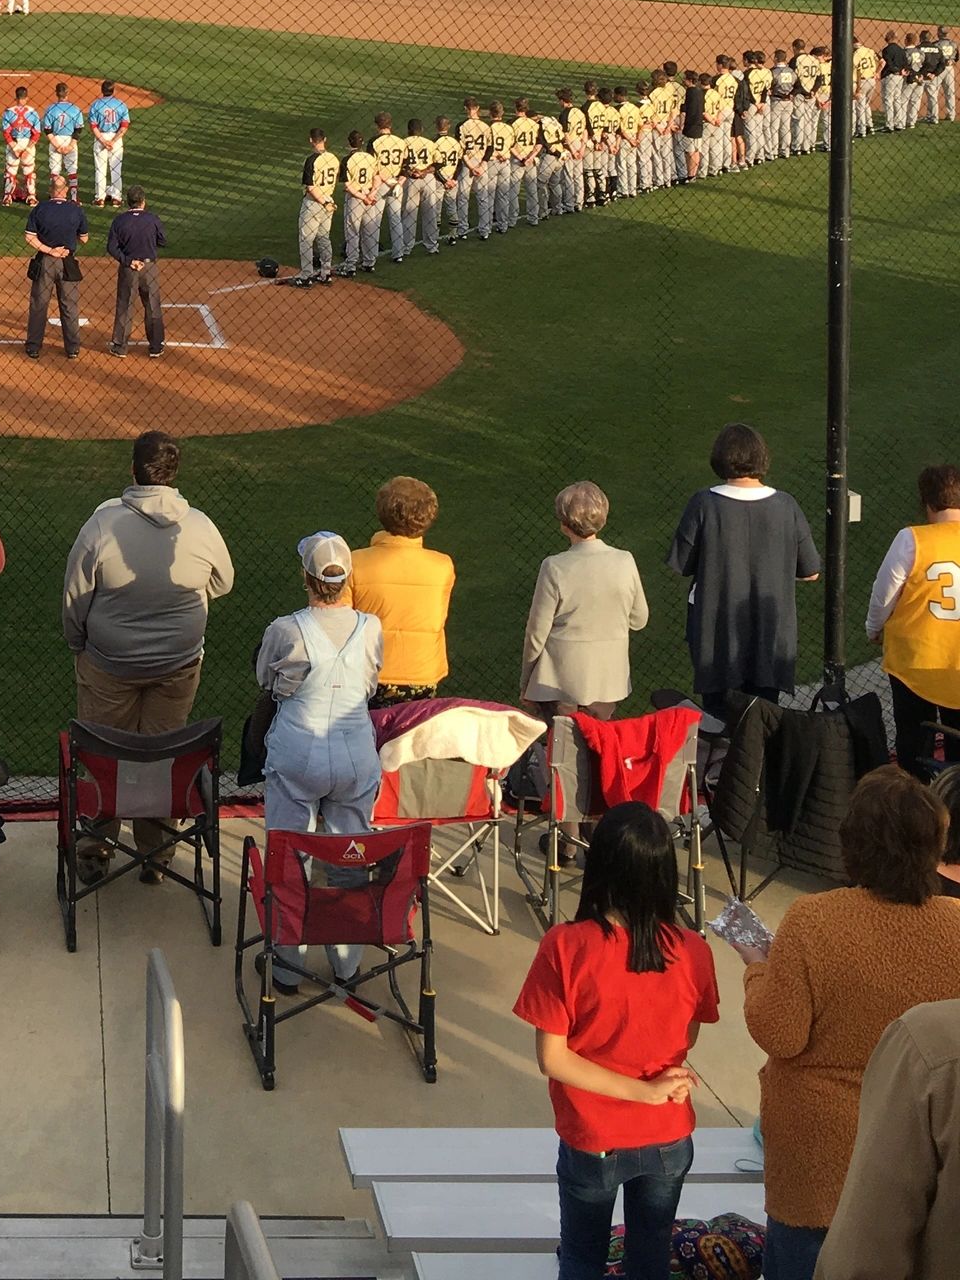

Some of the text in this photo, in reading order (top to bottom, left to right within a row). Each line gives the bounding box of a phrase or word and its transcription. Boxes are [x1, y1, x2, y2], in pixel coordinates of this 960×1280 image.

[803, 65, 818, 78] 30
[861, 57, 875, 70] 21
[464, 134, 486, 151] 24
[495, 136, 505, 152] 9
[517, 131, 535, 147] 41
[380, 148, 403, 166] 33
[407, 148, 429, 166] 44
[319, 167, 336, 187] 15
[358, 167, 367, 185] 8
